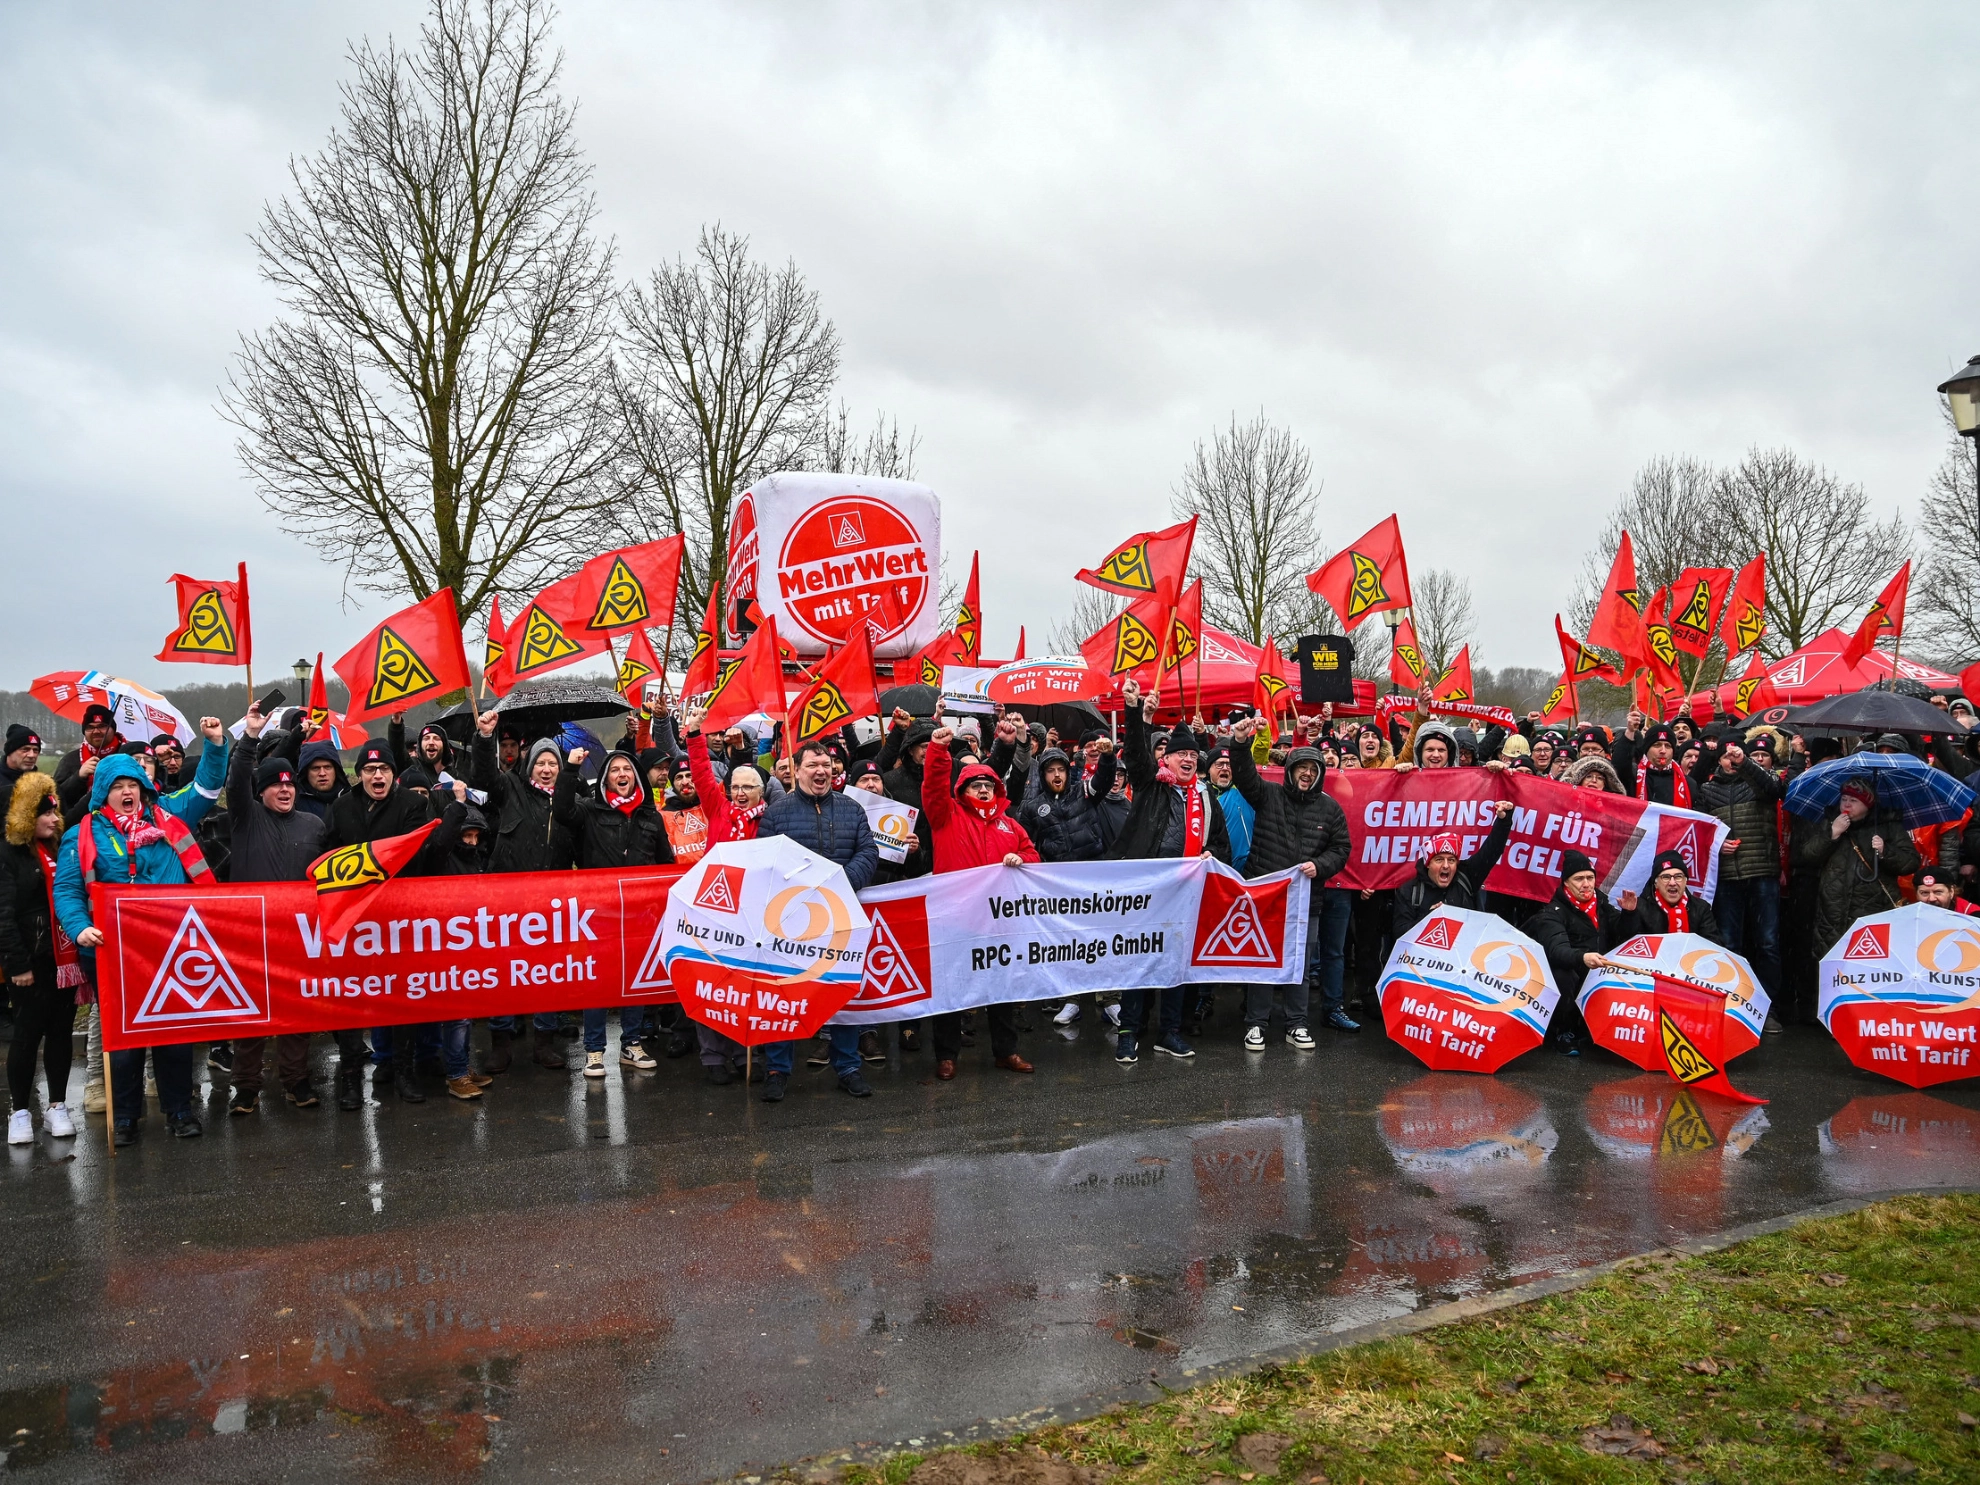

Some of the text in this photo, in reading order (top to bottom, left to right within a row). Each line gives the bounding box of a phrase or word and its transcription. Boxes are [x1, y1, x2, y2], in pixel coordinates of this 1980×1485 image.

[777, 547, 929, 599] MehrWert
[813, 585, 909, 623] mit Taf
[1312, 652, 1338, 662] WIR
[1006, 670, 1084, 684] Mehr Wert
[1013, 677, 1080, 695] mit Tarif
[1386, 695, 1413, 707] YOU
[1364, 799, 1602, 849] GEMEINSM FÜR
[1361, 836, 1431, 864] MEH
[988, 890, 1152, 920] Vertrauenskörper
[676, 918, 864, 963] HOLZ UND KUNSTSTOFF
[971, 931, 1164, 971] RPC - Bramlage GmbH
[300, 954, 598, 1000] unser gutes Recht
[1396, 954, 1551, 1019] HOLZ UND KUNSTSTOFF
[1833, 973, 1866, 988] HOLZ
[1871, 972, 1904, 983] UND
[695, 979, 809, 1016] Mehr Wert
[705, 1006, 799, 1032] mit Tarif
[1399, 996, 1497, 1042] Mehr Wert
[1614, 1024, 1646, 1044] mit
[1858, 1018, 1977, 1043] Mehr Wert
[1404, 1022, 1486, 1060] mit Tarif
[1871, 1042, 1971, 1066] mit Tarif
